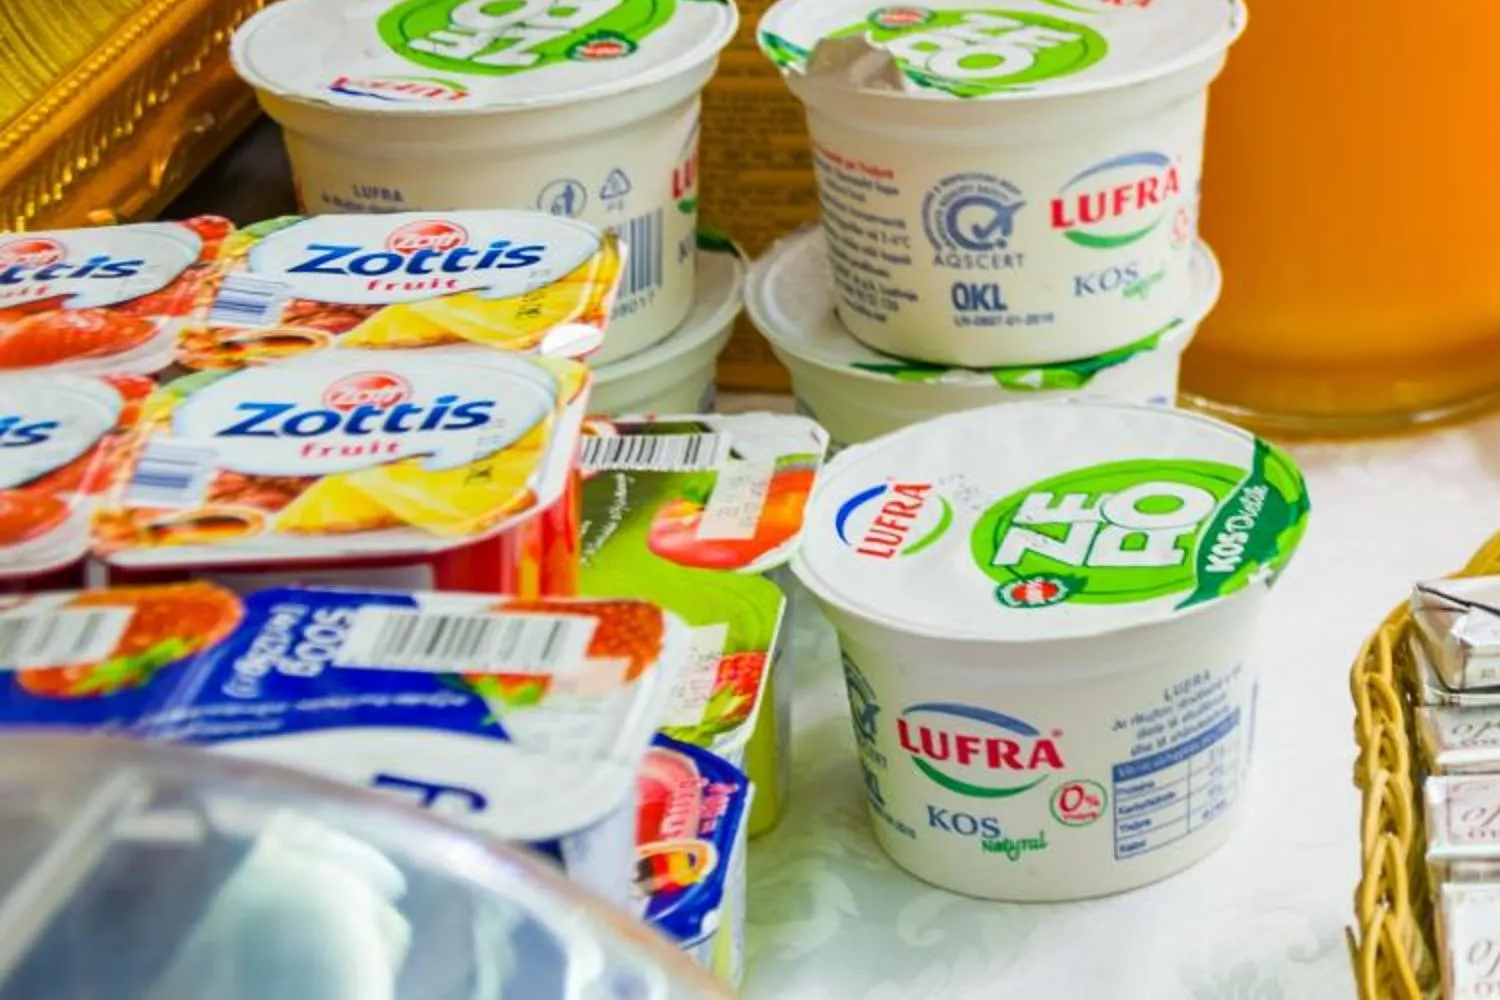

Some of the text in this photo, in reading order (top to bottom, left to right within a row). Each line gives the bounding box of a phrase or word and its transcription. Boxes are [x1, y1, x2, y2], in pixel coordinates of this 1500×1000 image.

[1051, 167, 1181, 229] LUFRA
[287, 235, 548, 277] Zottis
[933, 253, 1024, 269] AQSCERT
[366, 277, 459, 292] fruit
[1073, 261, 1140, 297] KOS
[214, 394, 497, 438] Zottis
[299, 441, 402, 459] fruit
[857, 481, 932, 560] LUFRA
[1205, 531, 1249, 573] KOS
[897, 718, 1065, 771] LUFRA
[926, 804, 1001, 839] KOS
